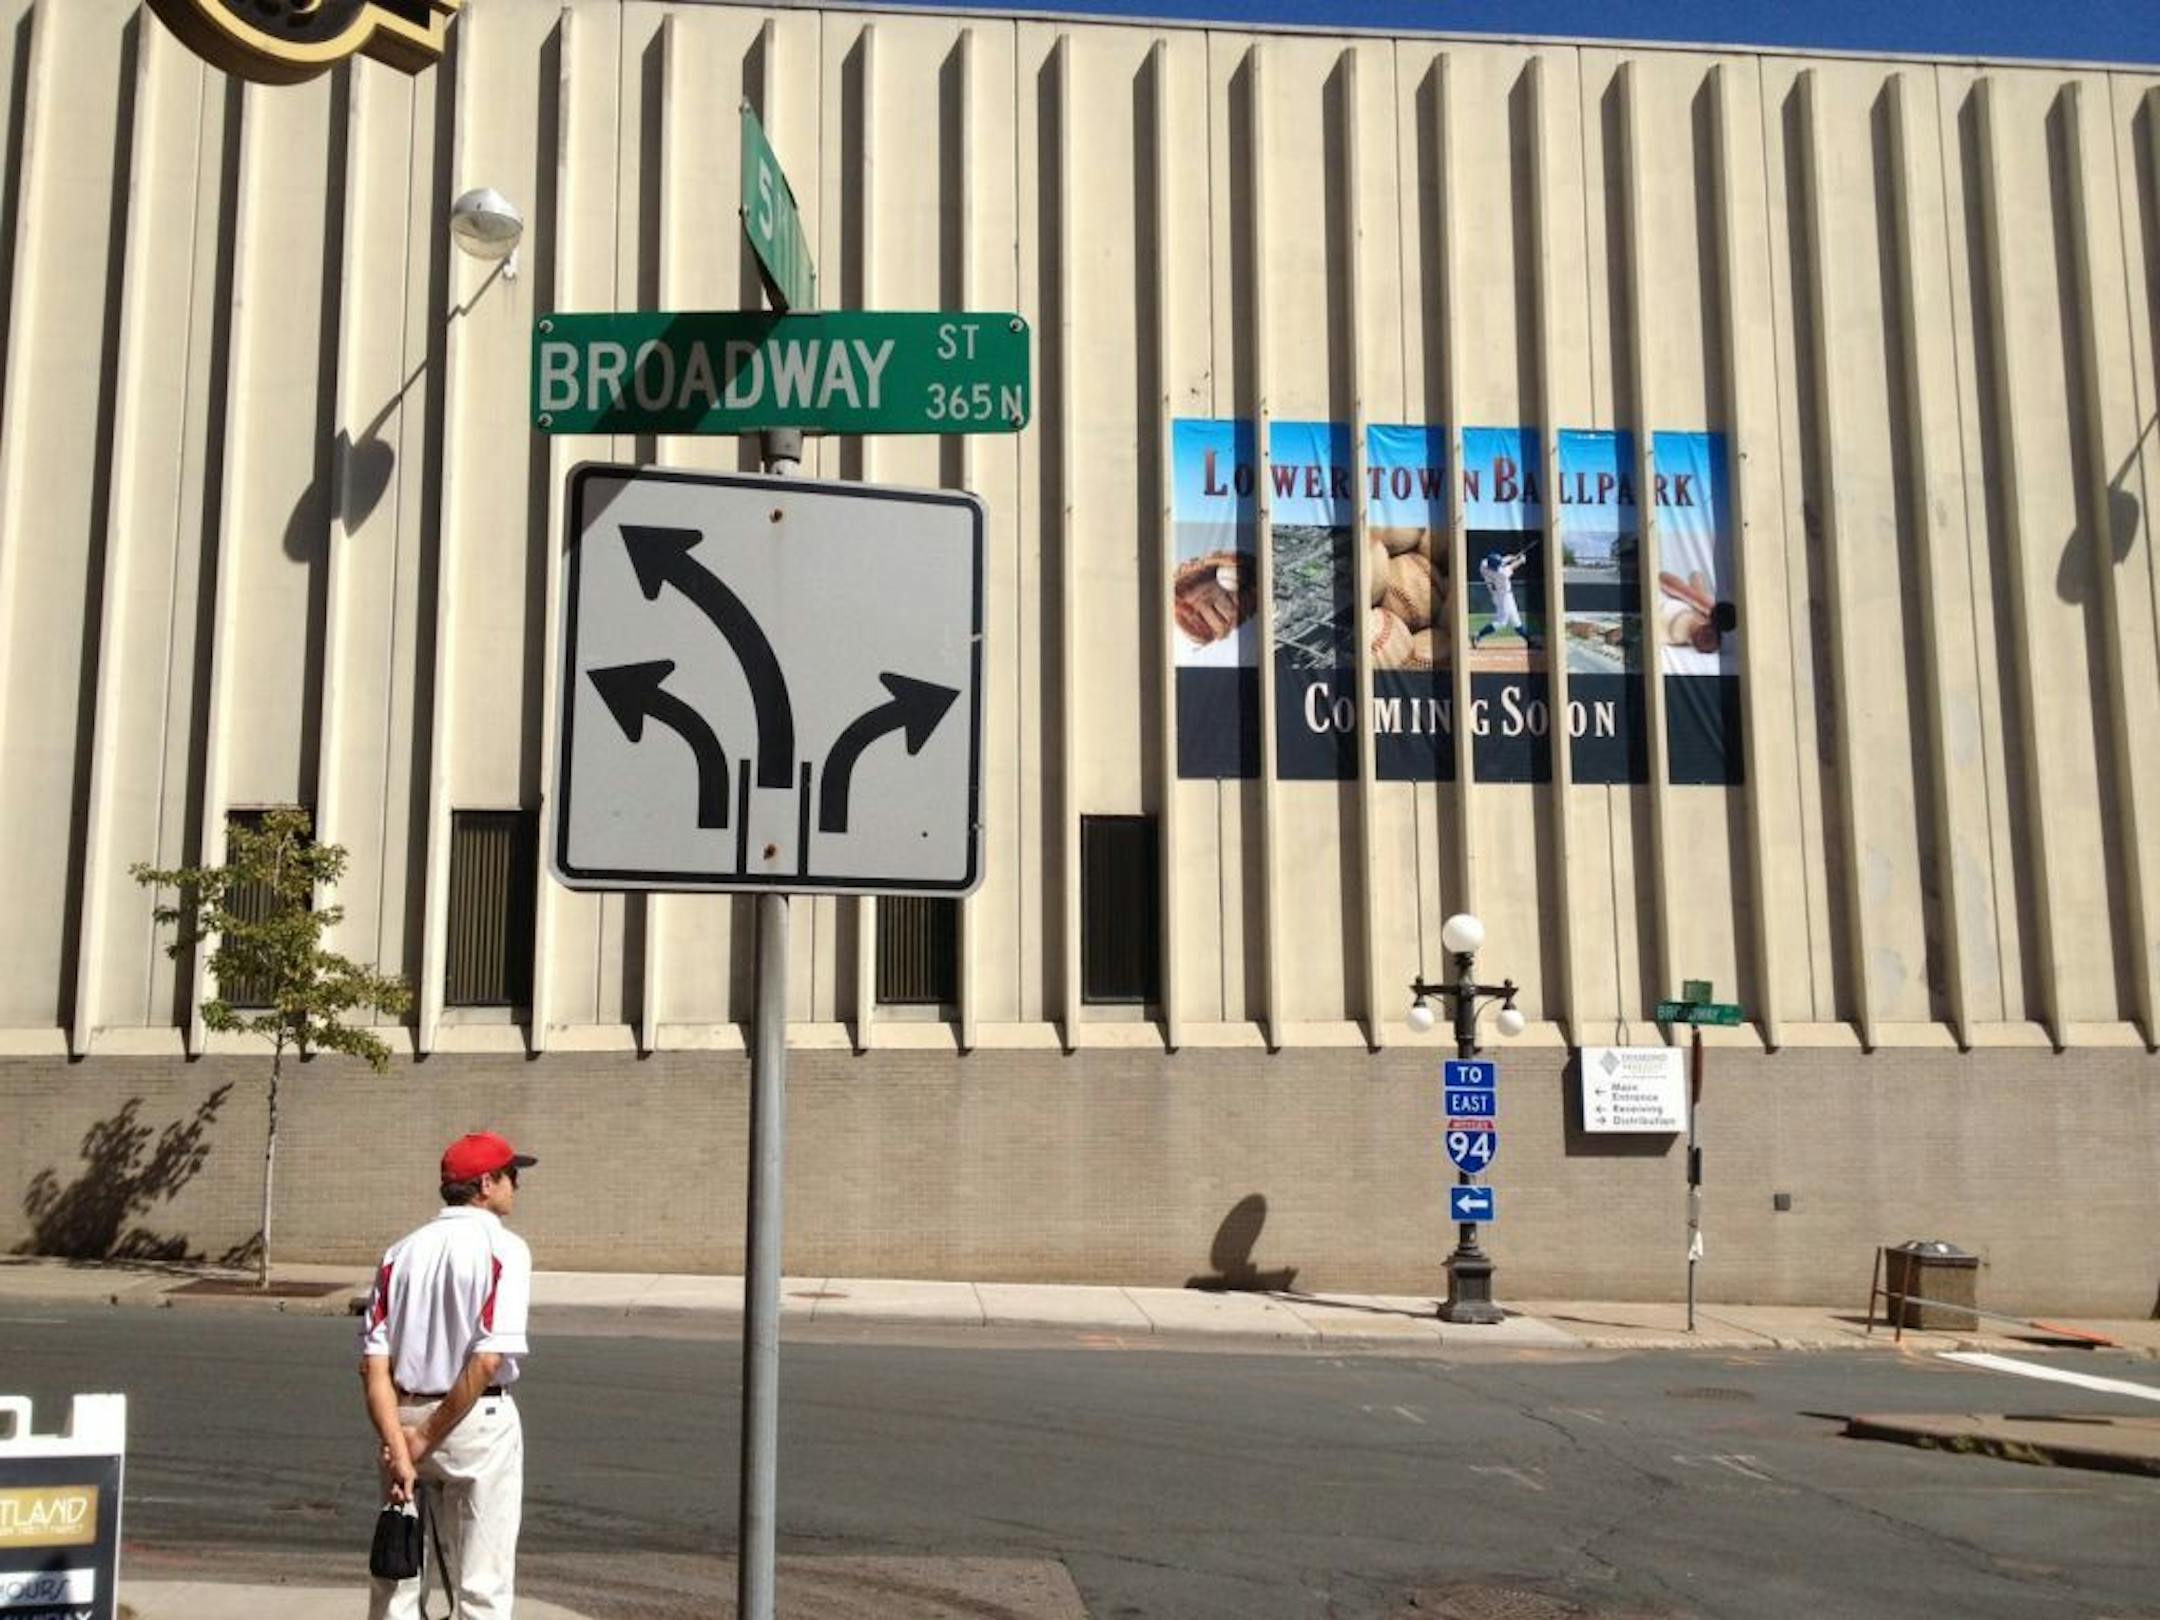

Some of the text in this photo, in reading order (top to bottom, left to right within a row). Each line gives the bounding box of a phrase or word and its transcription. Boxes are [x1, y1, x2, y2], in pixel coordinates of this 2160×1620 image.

[539, 323, 980, 412] BROADWAY ST
[1493, 455, 1695, 507] BALLPARK
[1304, 682, 1616, 738] COMING SOON
[1457, 1066, 1483, 1084] TO
[1611, 1082, 1638, 1092] Main
[1452, 1094, 1489, 1112] EAST
[1611, 1092, 1659, 1102] Entrance
[1612, 1104, 1663, 1116] Receiving
[1612, 1115, 1676, 1126] Distribution
[1449, 1131, 1492, 1164] 94
